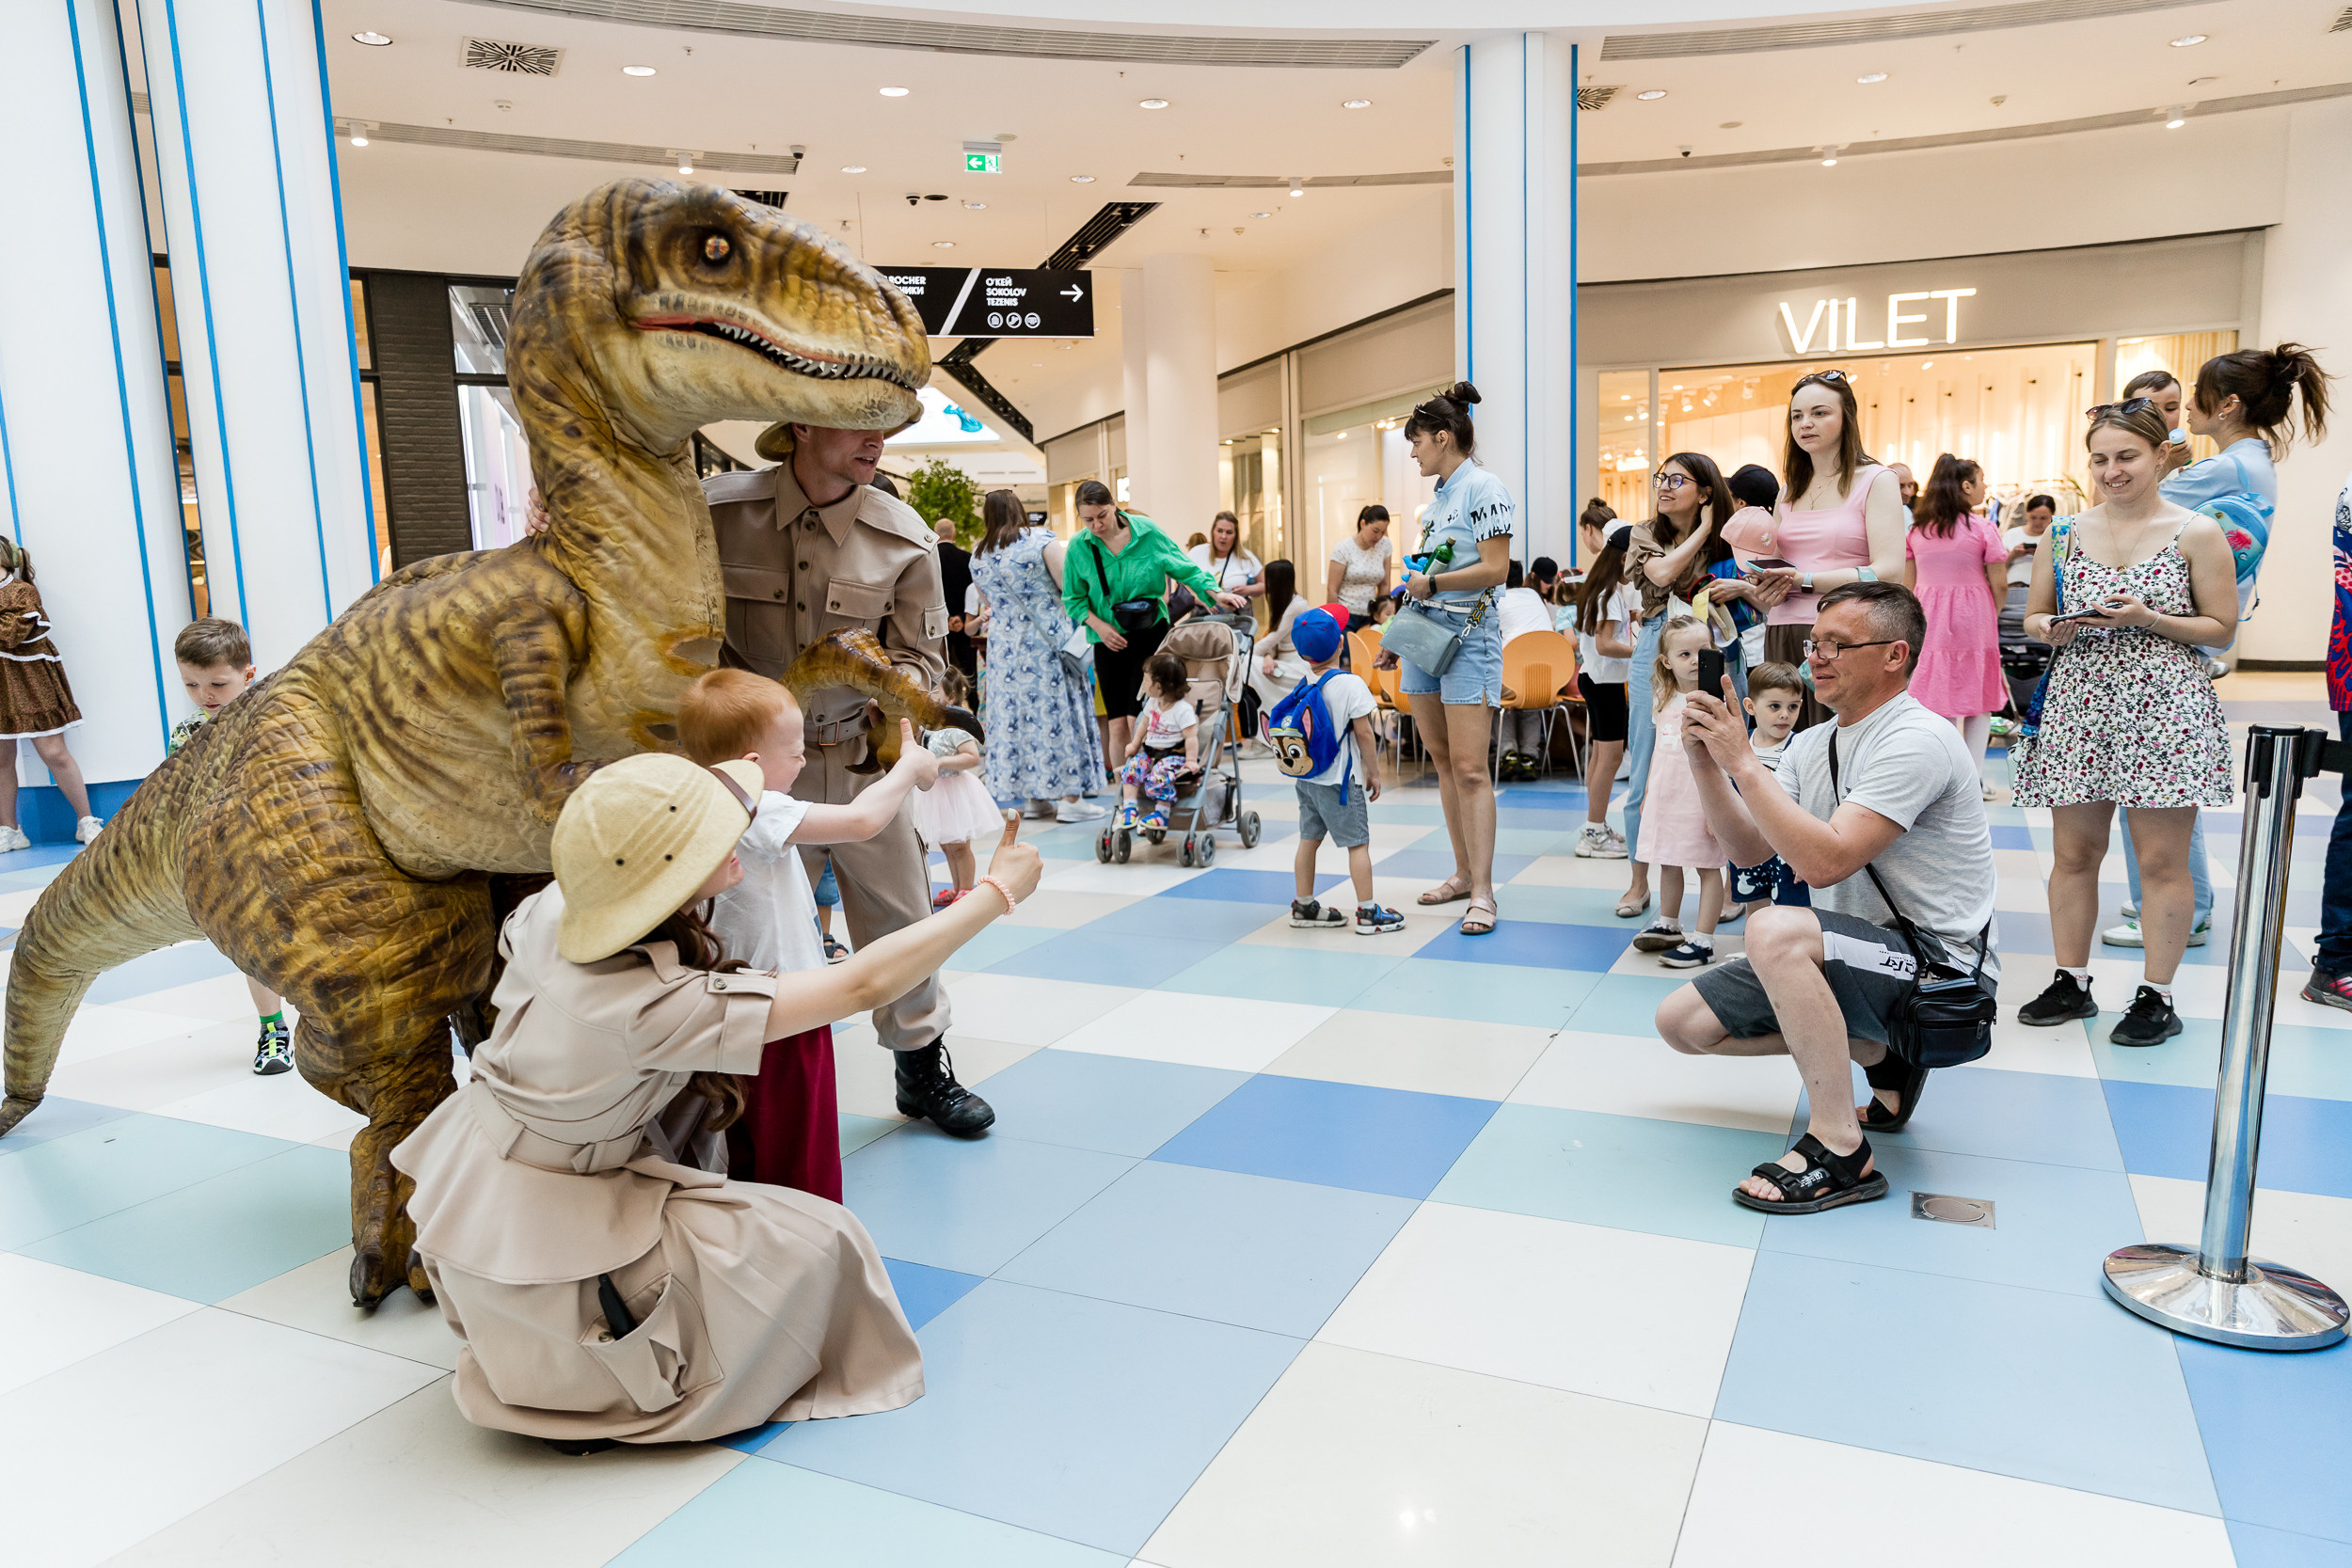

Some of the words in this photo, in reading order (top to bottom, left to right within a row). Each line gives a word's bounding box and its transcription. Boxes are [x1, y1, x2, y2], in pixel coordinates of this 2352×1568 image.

[888, 276, 927, 285] ROCHER
[986, 287, 1027, 296] SOKOLOV
[986, 297, 1019, 307] TEZENIS
[1779, 287, 1977, 354] VILET
